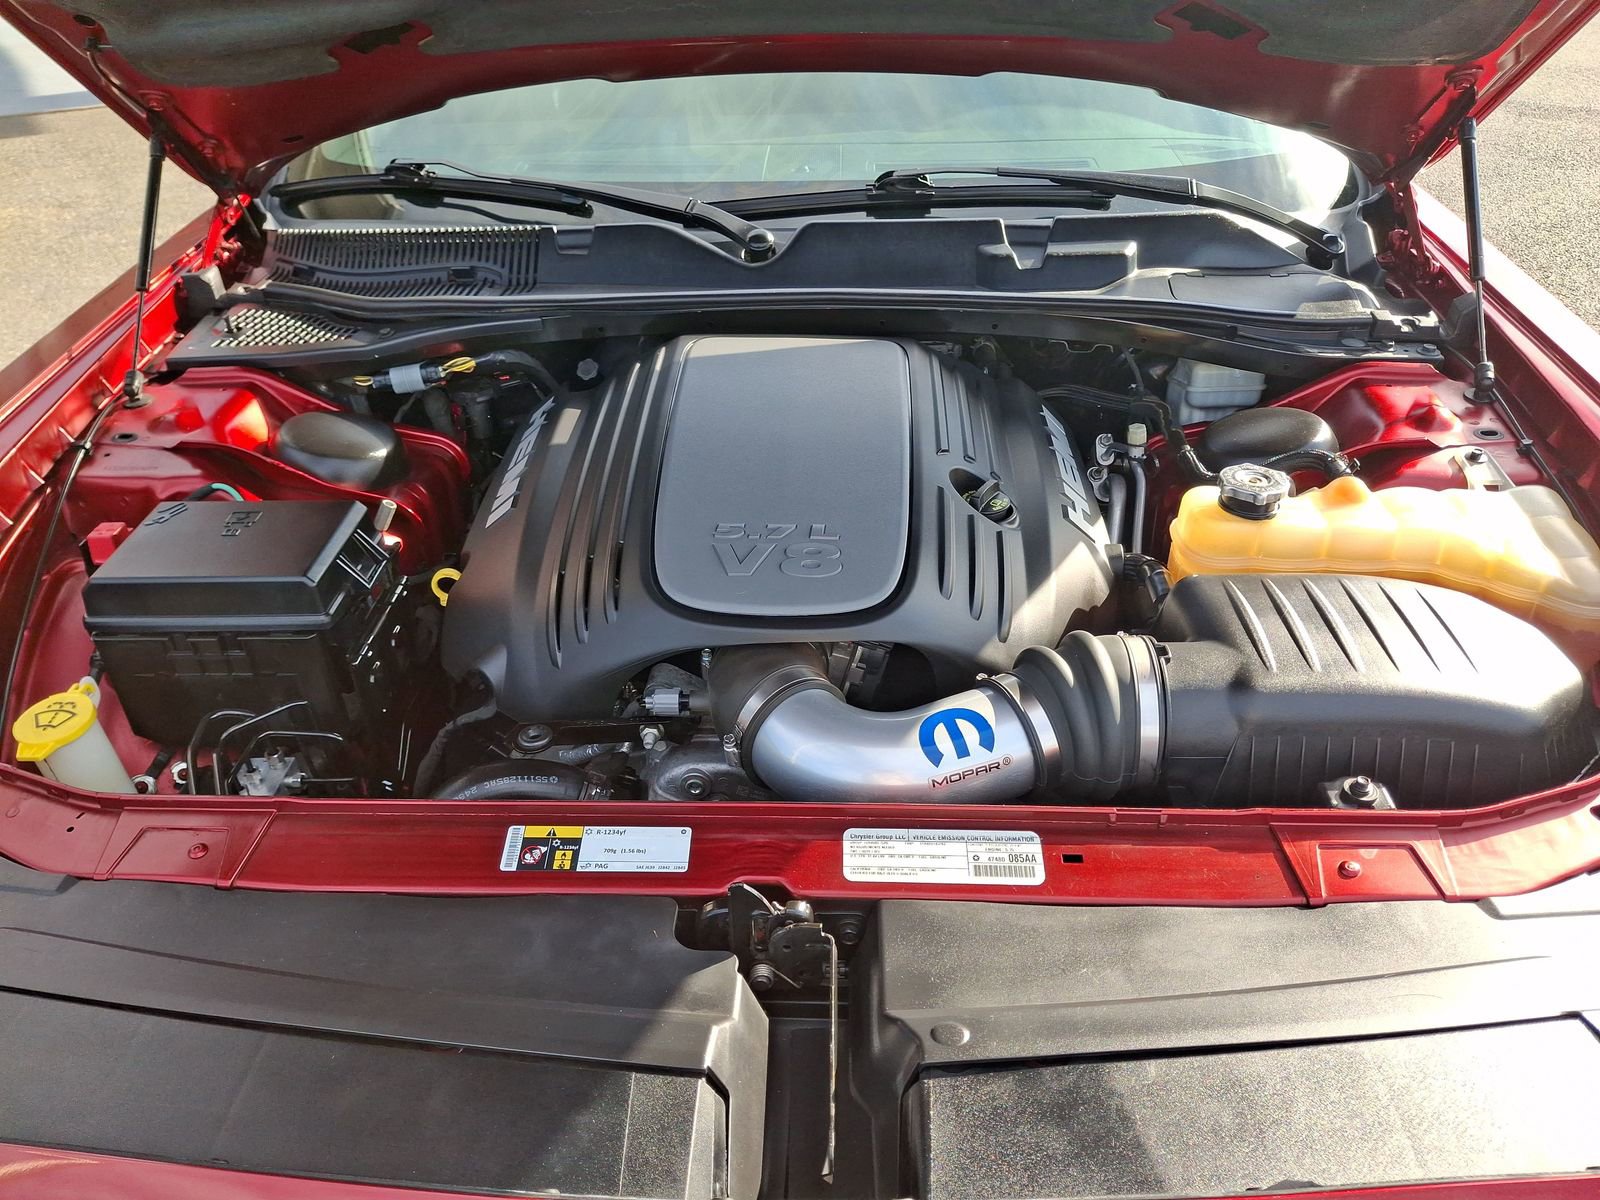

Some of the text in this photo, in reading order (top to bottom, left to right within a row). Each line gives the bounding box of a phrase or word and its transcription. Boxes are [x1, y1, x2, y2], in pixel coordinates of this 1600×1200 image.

[484, 396, 556, 529] HEMI
[1039, 404, 1098, 545] HEMI
[712, 542, 843, 578] V8
[850, 833, 874, 841] Chrysler
[1008, 853, 1037, 863] 085AA
